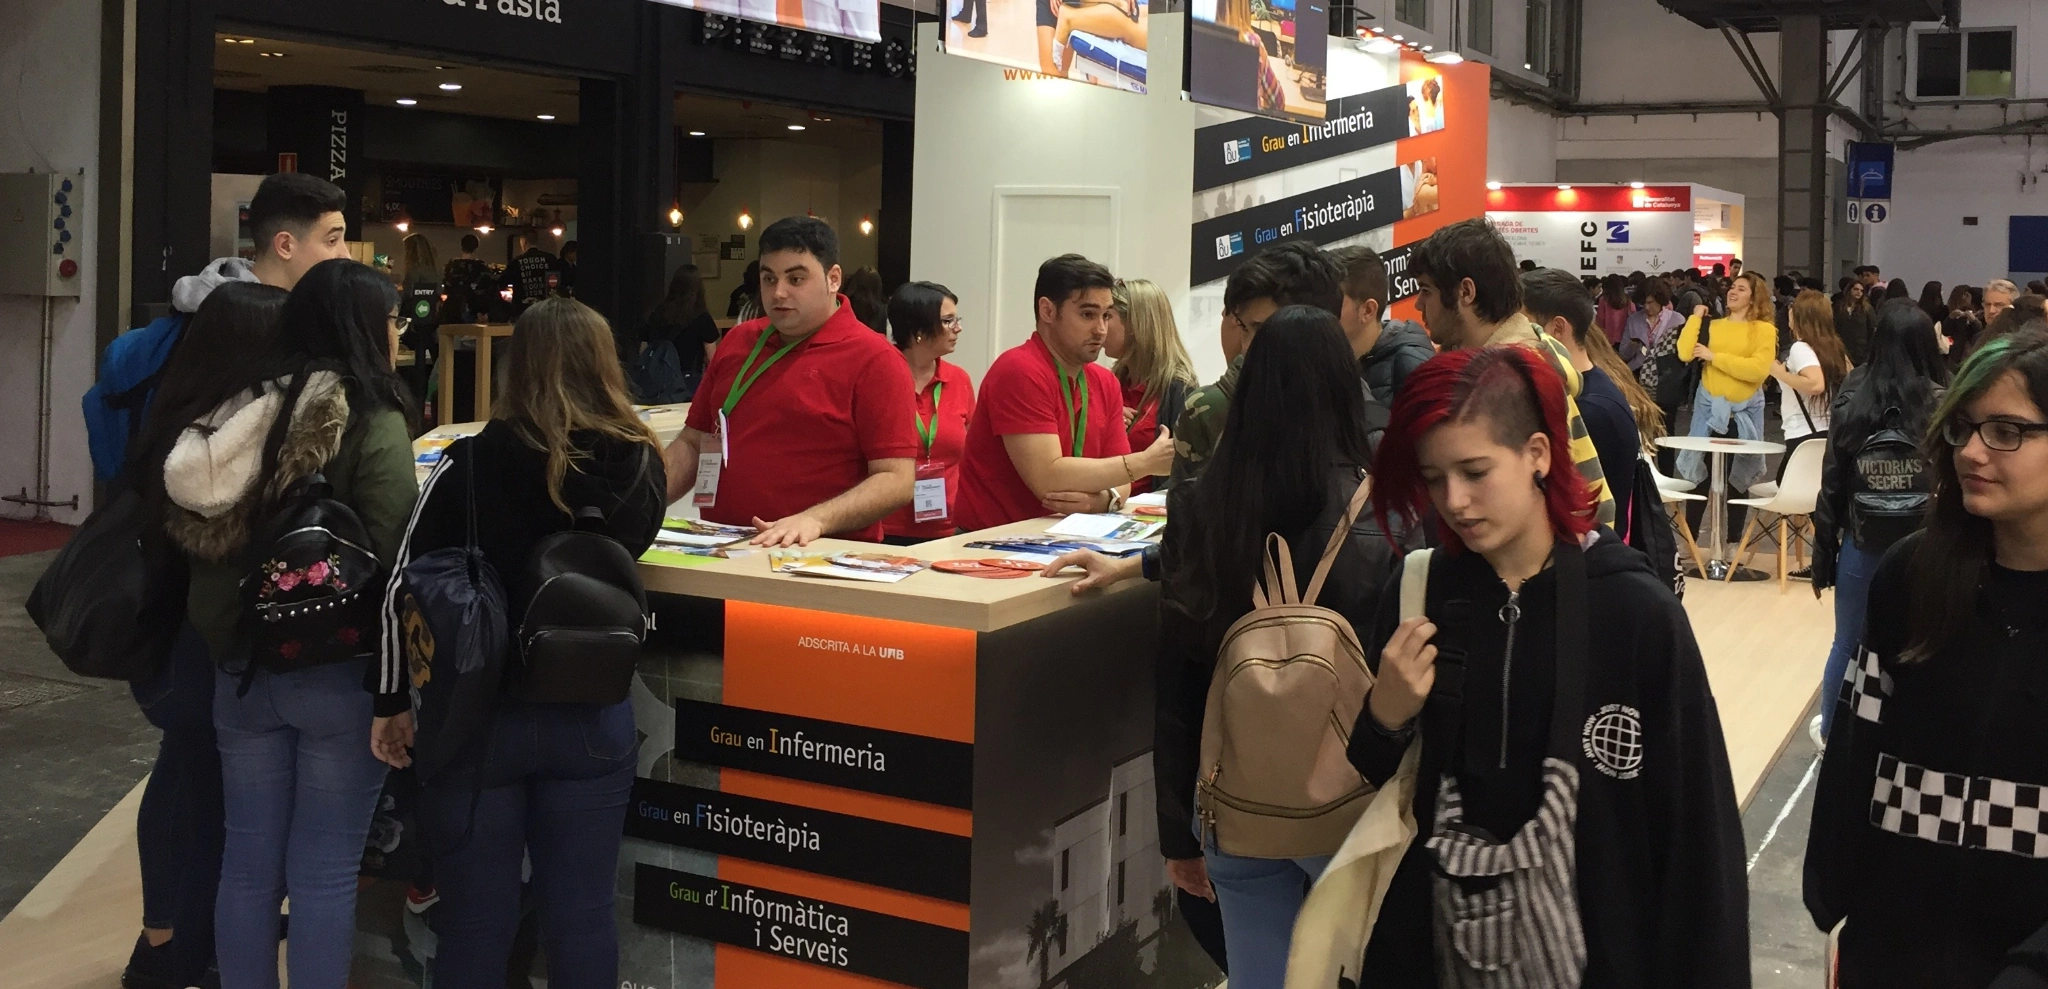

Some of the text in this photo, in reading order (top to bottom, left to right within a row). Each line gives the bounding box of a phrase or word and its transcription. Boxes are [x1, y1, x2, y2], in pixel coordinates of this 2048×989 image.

[474, 0, 562, 24] asta
[330, 109, 347, 182] PIZZA
[1262, 135, 1285, 153] Grau
[1287, 132, 1300, 147] en
[1255, 227, 1278, 244] Grau
[1280, 222, 1293, 236] en
[1295, 189, 1375, 232] Fisioteràpia
[414, 289, 435, 297] ENTRY
[1857, 458, 1923, 475] VICTORIA'S
[1867, 474, 1914, 490] SECRET
[798, 636, 850, 653] ADSCRITA
[852, 644, 860, 654] A
[862, 645, 876, 657] LA
[710, 726, 885, 771] Grau en Infermeria
[639, 801, 820, 852] Grau en Fisioteràpia
[669, 881, 700, 903] Grau
[755, 921, 848, 967] i Serveis
